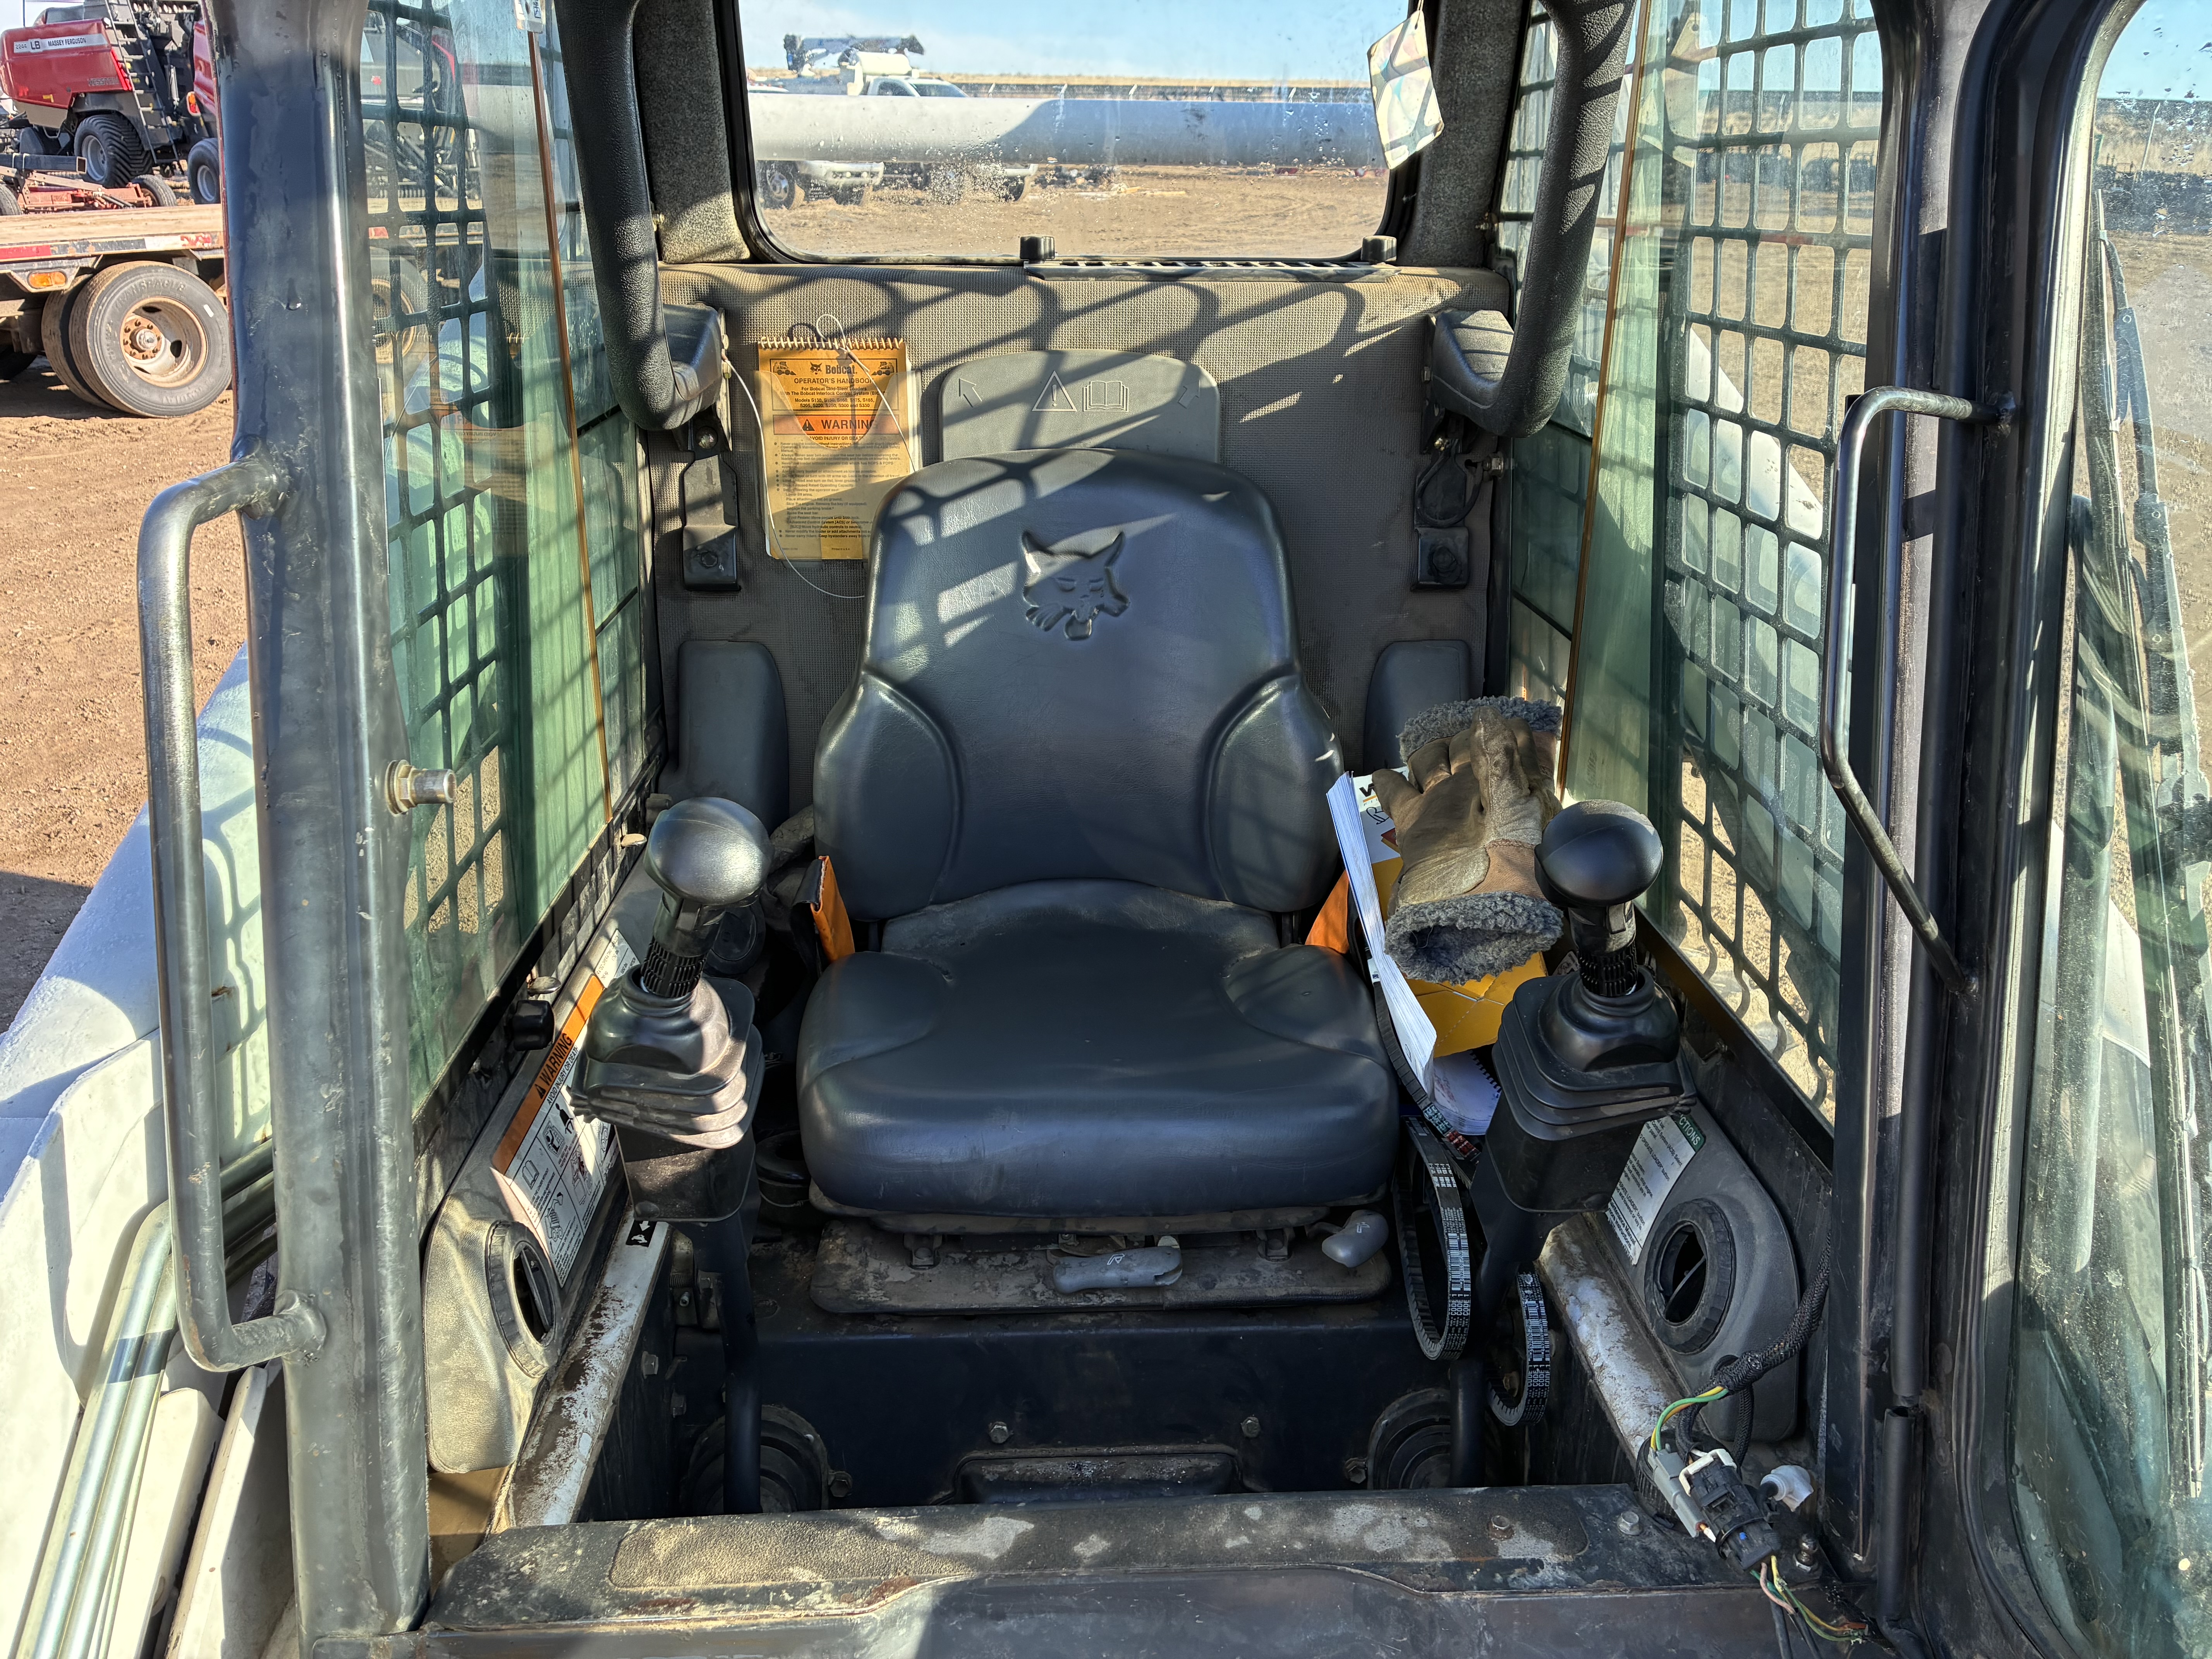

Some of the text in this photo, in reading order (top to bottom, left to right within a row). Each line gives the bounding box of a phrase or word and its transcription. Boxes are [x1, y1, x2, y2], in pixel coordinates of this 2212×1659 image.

[31, 41, 41, 50] LB
[825, 365, 855, 374] Bobcat
[539, 1032, 573, 1086] WARNING
[546, 1045, 579, 1106] AVOID INJURY OR DEATH
[1680, 1115, 1700, 1145] CTIONS
